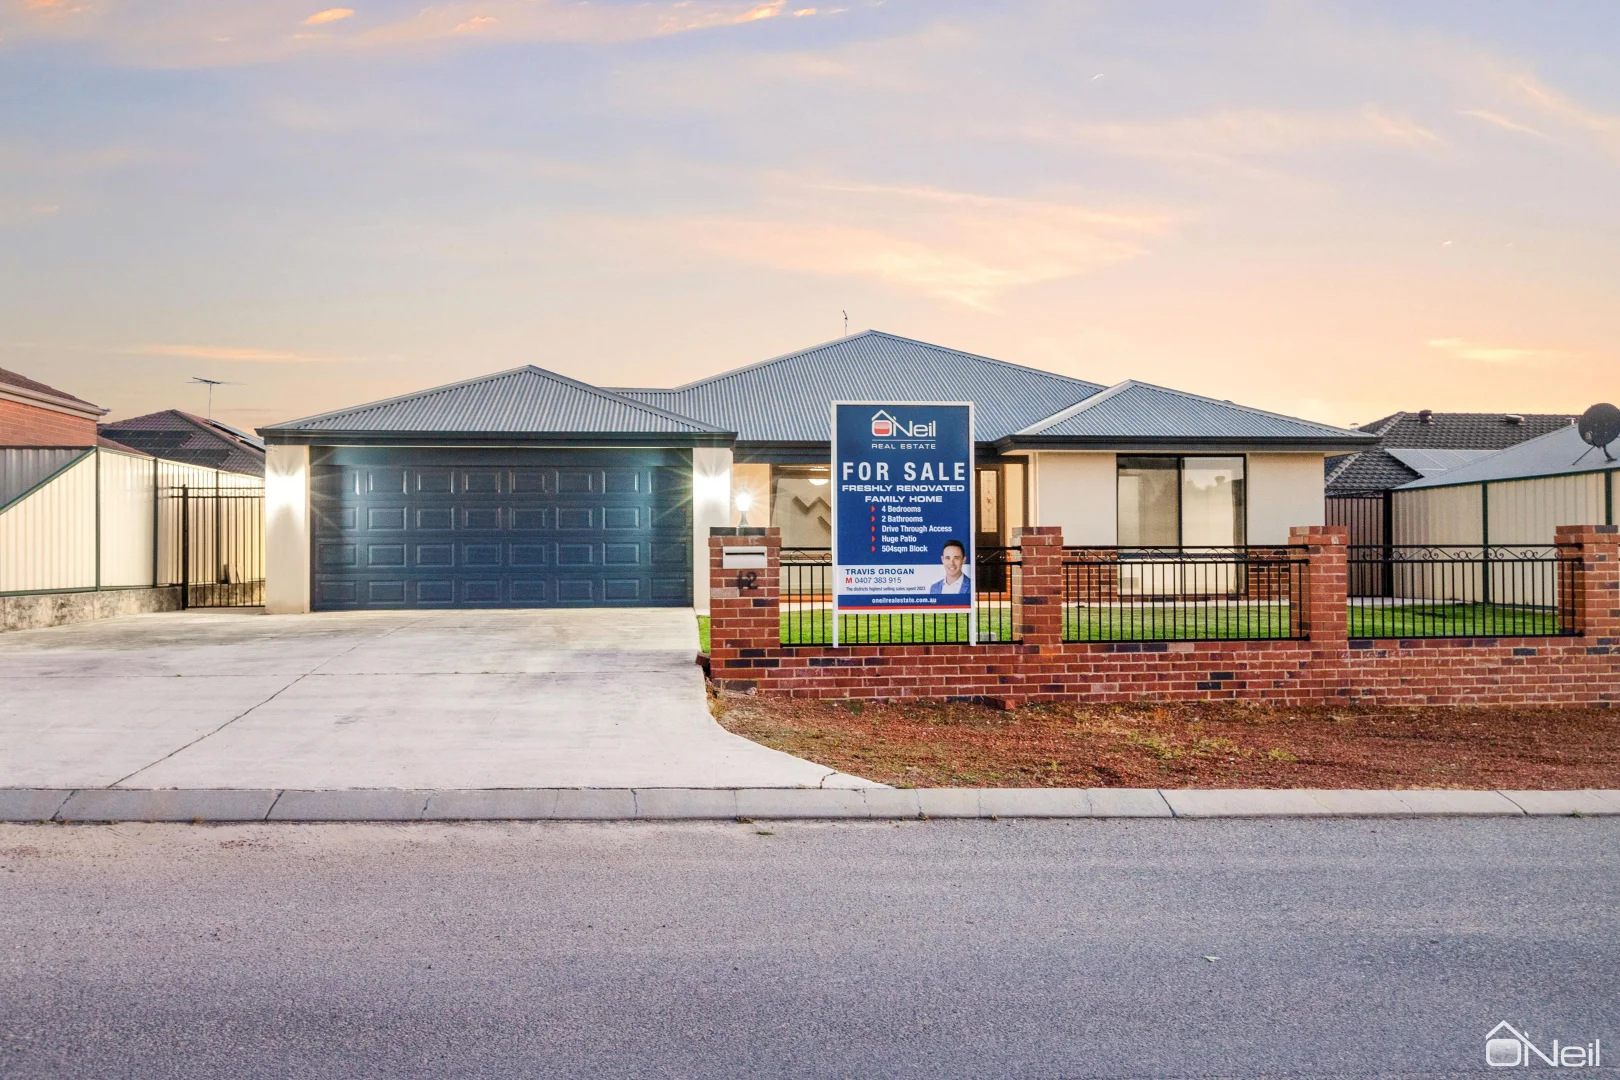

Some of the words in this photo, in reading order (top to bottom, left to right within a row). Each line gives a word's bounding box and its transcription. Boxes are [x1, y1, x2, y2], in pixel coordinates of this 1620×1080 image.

[842, 461, 889, 481] FOR
[903, 461, 966, 481] SALE
[864, 495, 906, 503] FAMILY
[909, 495, 943, 503] HOME
[881, 505, 886, 513] 4
[887, 505, 922, 513] Bedrooms
[881, 515, 886, 523] 2
[887, 515, 923, 523] Bathrooms
[881, 525, 899, 533] Drive
[900, 525, 928, 534] Through
[928, 525, 952, 533] Access
[881, 535, 898, 544] Huge
[900, 535, 917, 543] Patio
[881, 545, 908, 554] 504sqm
[909, 545, 928, 553] Block
[737, 571, 758, 590] 12
